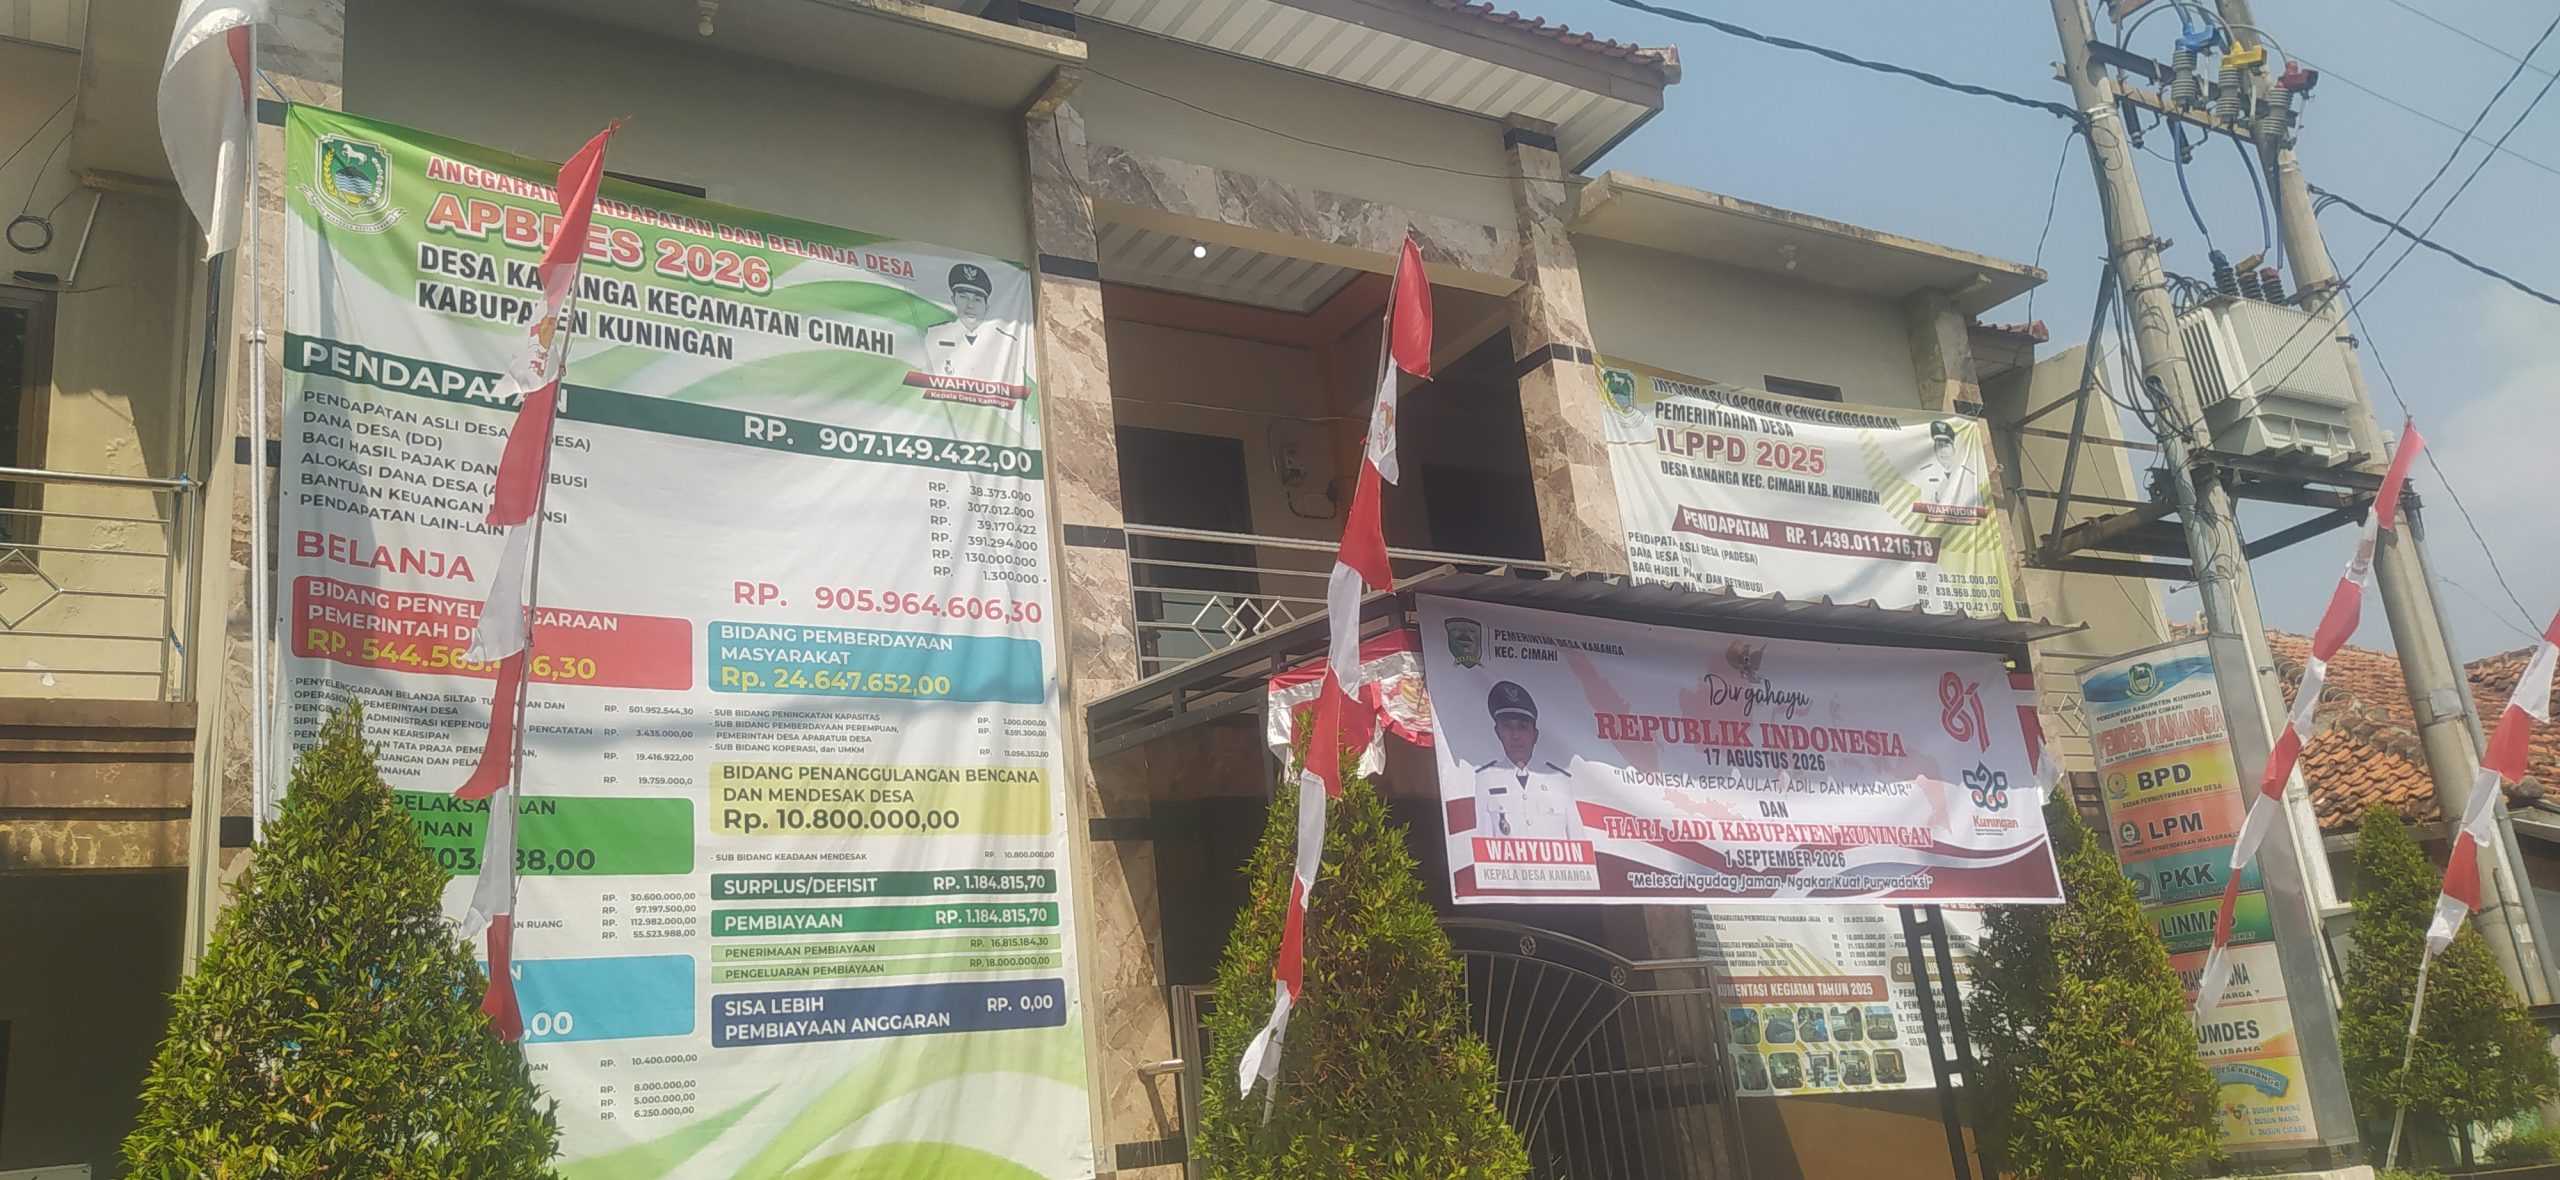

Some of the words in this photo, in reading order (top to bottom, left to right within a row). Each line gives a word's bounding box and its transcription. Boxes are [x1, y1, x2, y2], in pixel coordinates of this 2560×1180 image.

[427, 157, 558, 203] ANGGARAN
[718, 225, 763, 248] DAN
[769, 236, 859, 266] BELANJA
[865, 254, 916, 279] DESA
[656, 239, 769, 289] 2026
[421, 246, 496, 282] DESA
[507, 264, 637, 308] KAANGA
[648, 288, 800, 338] KECAMATAN
[809, 320, 894, 355] CIMAHI
[419, 283, 587, 335] KABUPAEN
[599, 315, 733, 360] KUNINGAN
[929, 377, 1010, 398] WAHYUDIN
[931, 391, 957, 401] Kepala
[959, 394, 976, 403] Desa
[304, 390, 417, 424] PENDAPATAN
[422, 416, 459, 432] ASLI
[1653, 379, 1722, 404] INFORMASI
[1726, 392, 1781, 416] LAPORAN
[1785, 404, 1901, 431] PENYELENGGARAAN
[303, 411, 352, 430] DANA
[356, 422, 400, 441] DESA
[1655, 402, 1757, 433] PEMERINTAHAN
[1761, 419, 1794, 437] DESA
[302, 432, 344, 449] BAGI
[349, 440, 397, 459] HASIL
[401, 451, 455, 471] PAJAK
[745, 416, 794, 445] RP.
[819, 429, 1032, 472] 907.149.422,00
[1656, 427, 1747, 463] ILPPD
[1756, 440, 1825, 474] 2025
[301, 452, 373, 477] ALOKASI
[379, 466, 426, 486] DANA
[432, 475, 476, 494] DESA
[1661, 461, 1689, 478] DESA
[1691, 467, 1740, 486] KANANGA
[1742, 473, 1765, 490] KEC.
[1767, 476, 1806, 494] CIMAHI
[1808, 482, 1830, 498] KAB.
[1832, 485, 1880, 504] KUNINGAN
[302, 473, 383, 499] BANTUAN
[389, 488, 483, 514] KEUANGAN
[969, 485, 1032, 502] 38.373.000
[300, 494, 416, 523] PENDAPATAN
[968, 502, 1034, 519] 307.012.000
[1926, 504, 1977, 516] WAHYUDIN
[977, 520, 1036, 535] 39.170.422
[1683, 509, 1769, 540] PENDAPATAN
[1785, 526, 1806, 545] RP.
[1810, 531, 1933, 558] 1,439.011.216,78
[968, 536, 1038, 551] 391.294.000
[1680, 542, 1699, 553] ASLI
[1721, 549, 1758, 566] (PADESA)
[965, 553, 1037, 568] 130.000.000
[296, 530, 475, 583] BELANJA
[733, 581, 787, 607] RP.
[815, 586, 1042, 624] 905.964.606,30
[1938, 573, 1998, 585] 38.373.000,00
[309, 580, 390, 609] BIDANG
[309, 604, 448, 639] PEMERINTAH
[721, 626, 797, 642] BIDANG
[803, 629, 953, 651] PEMBERDAYAAN
[1582, 641, 1624, 657] KANANGA
[721, 647, 851, 665] MASYARAKAT
[1494, 646, 1518, 660] KEC.
[1521, 647, 1558, 662] CIMAHI
[773, 668, 951, 697] 24.647.652,00
[396, 690, 441, 702] BELANJA
[1704, 674, 1811, 719] Dirgahayu
[2133, 699, 2171, 713] KABUPATEN
[2173, 690, 2212, 702] KUNINGAN
[629, 705, 694, 716] 501.952.544,30
[772, 711, 833, 720] PENINGKATAN
[529, 725, 593, 736] PENCATATAN
[636, 729, 693, 739] 3.435.000,00
[716, 732, 774, 741] PEMERINTAH
[772, 722, 844, 731] PEMBERDAYAAN
[1594, 712, 1754, 748] REPUBLIK
[1760, 723, 1907, 758] INDONESIA
[2146, 704, 2227, 746] KANANGA
[636, 753, 694, 762] 19.416.922,00
[1704, 748, 1720, 766] 17
[1727, 749, 1788, 770] AGUSTUS
[1792, 754, 1825, 772] 2026
[723, 765, 793, 780] BIDANG
[799, 766, 960, 783] PENANGGULANGAN
[966, 769, 1040, 783] BENCANA
[1699, 775, 1783, 794] BERDAULAT,
[1787, 779, 1816, 794] ADIL
[1820, 780, 1845, 795] DAN
[2137, 763, 2191, 792] BPD
[723, 788, 762, 802] DAN
[769, 788, 865, 803] MENDESAK
[871, 789, 914, 804] DESA
[2204, 783, 2222, 793] DESA
[1759, 800, 1789, 818] DAN
[724, 808, 768, 834] Rp.
[776, 808, 960, 833] 10.800.000,00
[1604, 816, 1662, 841] HARI
[1669, 820, 1717, 842] JADI
[1721, 823, 1836, 845] KABUPATEN
[1838, 825, 1933, 847] KUNINGAN
[1972, 815, 2019, 831] Kuningan
[2148, 812, 2203, 840] LPM
[1486, 839, 1584, 862] WAHYUDIN
[1736, 850, 1811, 868] SEPTEMBER
[1814, 851, 1846, 868] 2026
[724, 877, 878, 896] SURPLUS/DEFISIT
[964, 875, 1045, 891] 1.184.815,70
[1484, 867, 1520, 882] KEPALA
[1522, 868, 1546, 882] DESA
[1549, 868, 1592, 882] KANANGA
[1687, 875, 1738, 892] Ngudag
[1787, 876, 1831, 891] Ngakar
[1835, 876, 1861, 889] Kuat
[2159, 863, 2215, 891] PKK
[527, 919, 563, 929] RUANG
[724, 913, 844, 931] PEMBIAYAAN
[965, 908, 1047, 925] 1.184.815,70
[725, 946, 801, 959] PENERIMAAN
[804, 943, 876, 956] PEMBIAYAAN
[991, 937, 1049, 948] 16.815.184,30
[725, 967, 810, 979] PENGELUARAN
[813, 964, 885, 976] PEMBIAYAAN
[985, 956, 1050, 968] 18.000.000,00
[1771, 982, 1815, 997] KEGIATAN
[1817, 982, 1848, 996] TAHUN
[1851, 982, 1873, 996] 2025
[725, 1001, 766, 1017] SISA
[771, 997, 824, 1015] LEBIH
[1020, 995, 1053, 1012] 0,00
[725, 1021, 846, 1041] PEMBIAYAAN
[851, 1012, 950, 1034] ANGGARAN
[2196, 1019, 2260, 1044] UMDES
[2220, 1045, 2261, 1055] USAHA
